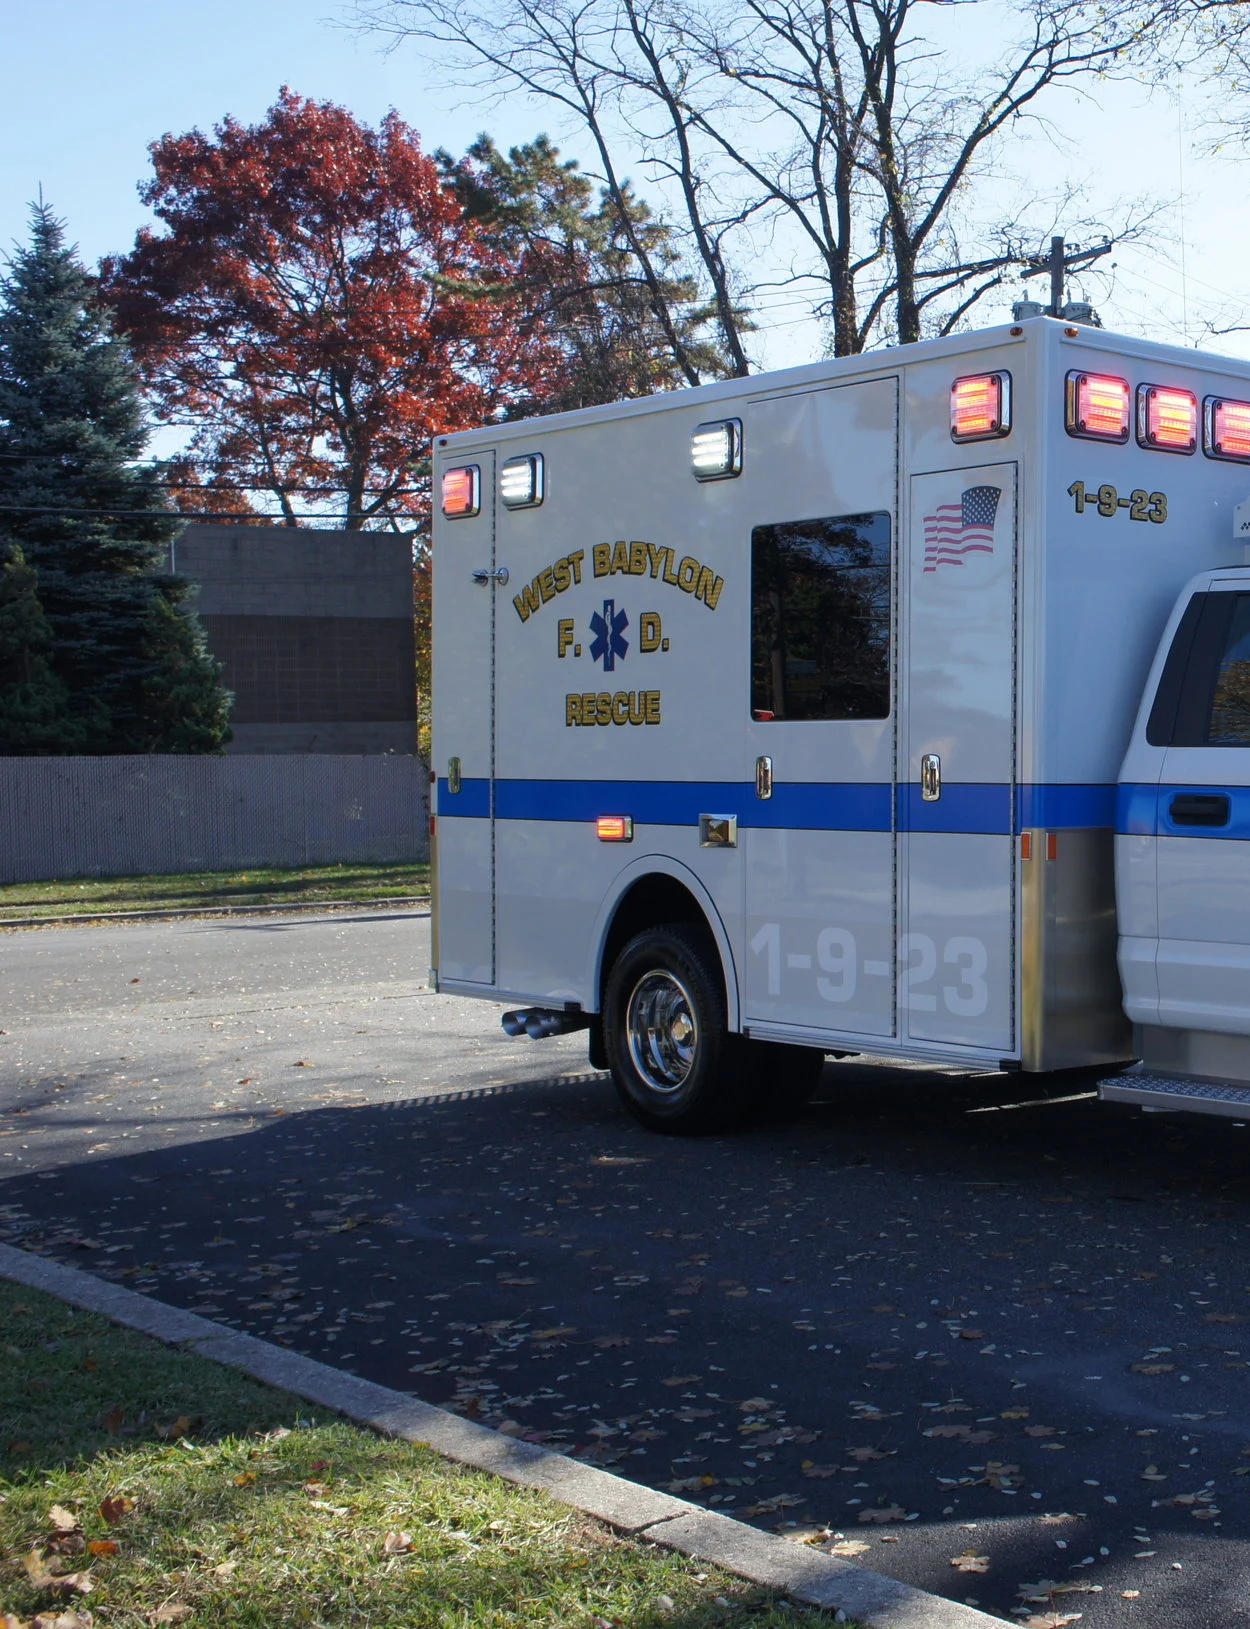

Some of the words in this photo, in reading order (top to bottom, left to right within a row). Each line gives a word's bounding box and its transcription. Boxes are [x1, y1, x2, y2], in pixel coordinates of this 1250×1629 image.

[1067, 480, 1168, 524] 1-9-23
[512, 549, 584, 623] WEST
[593, 541, 725, 611] BABYLON
[558, 618, 582, 658] F.
[639, 611, 670, 653] D.
[565, 690, 661, 726] RESCUE
[749, 922, 988, 1017] 1-9-23
